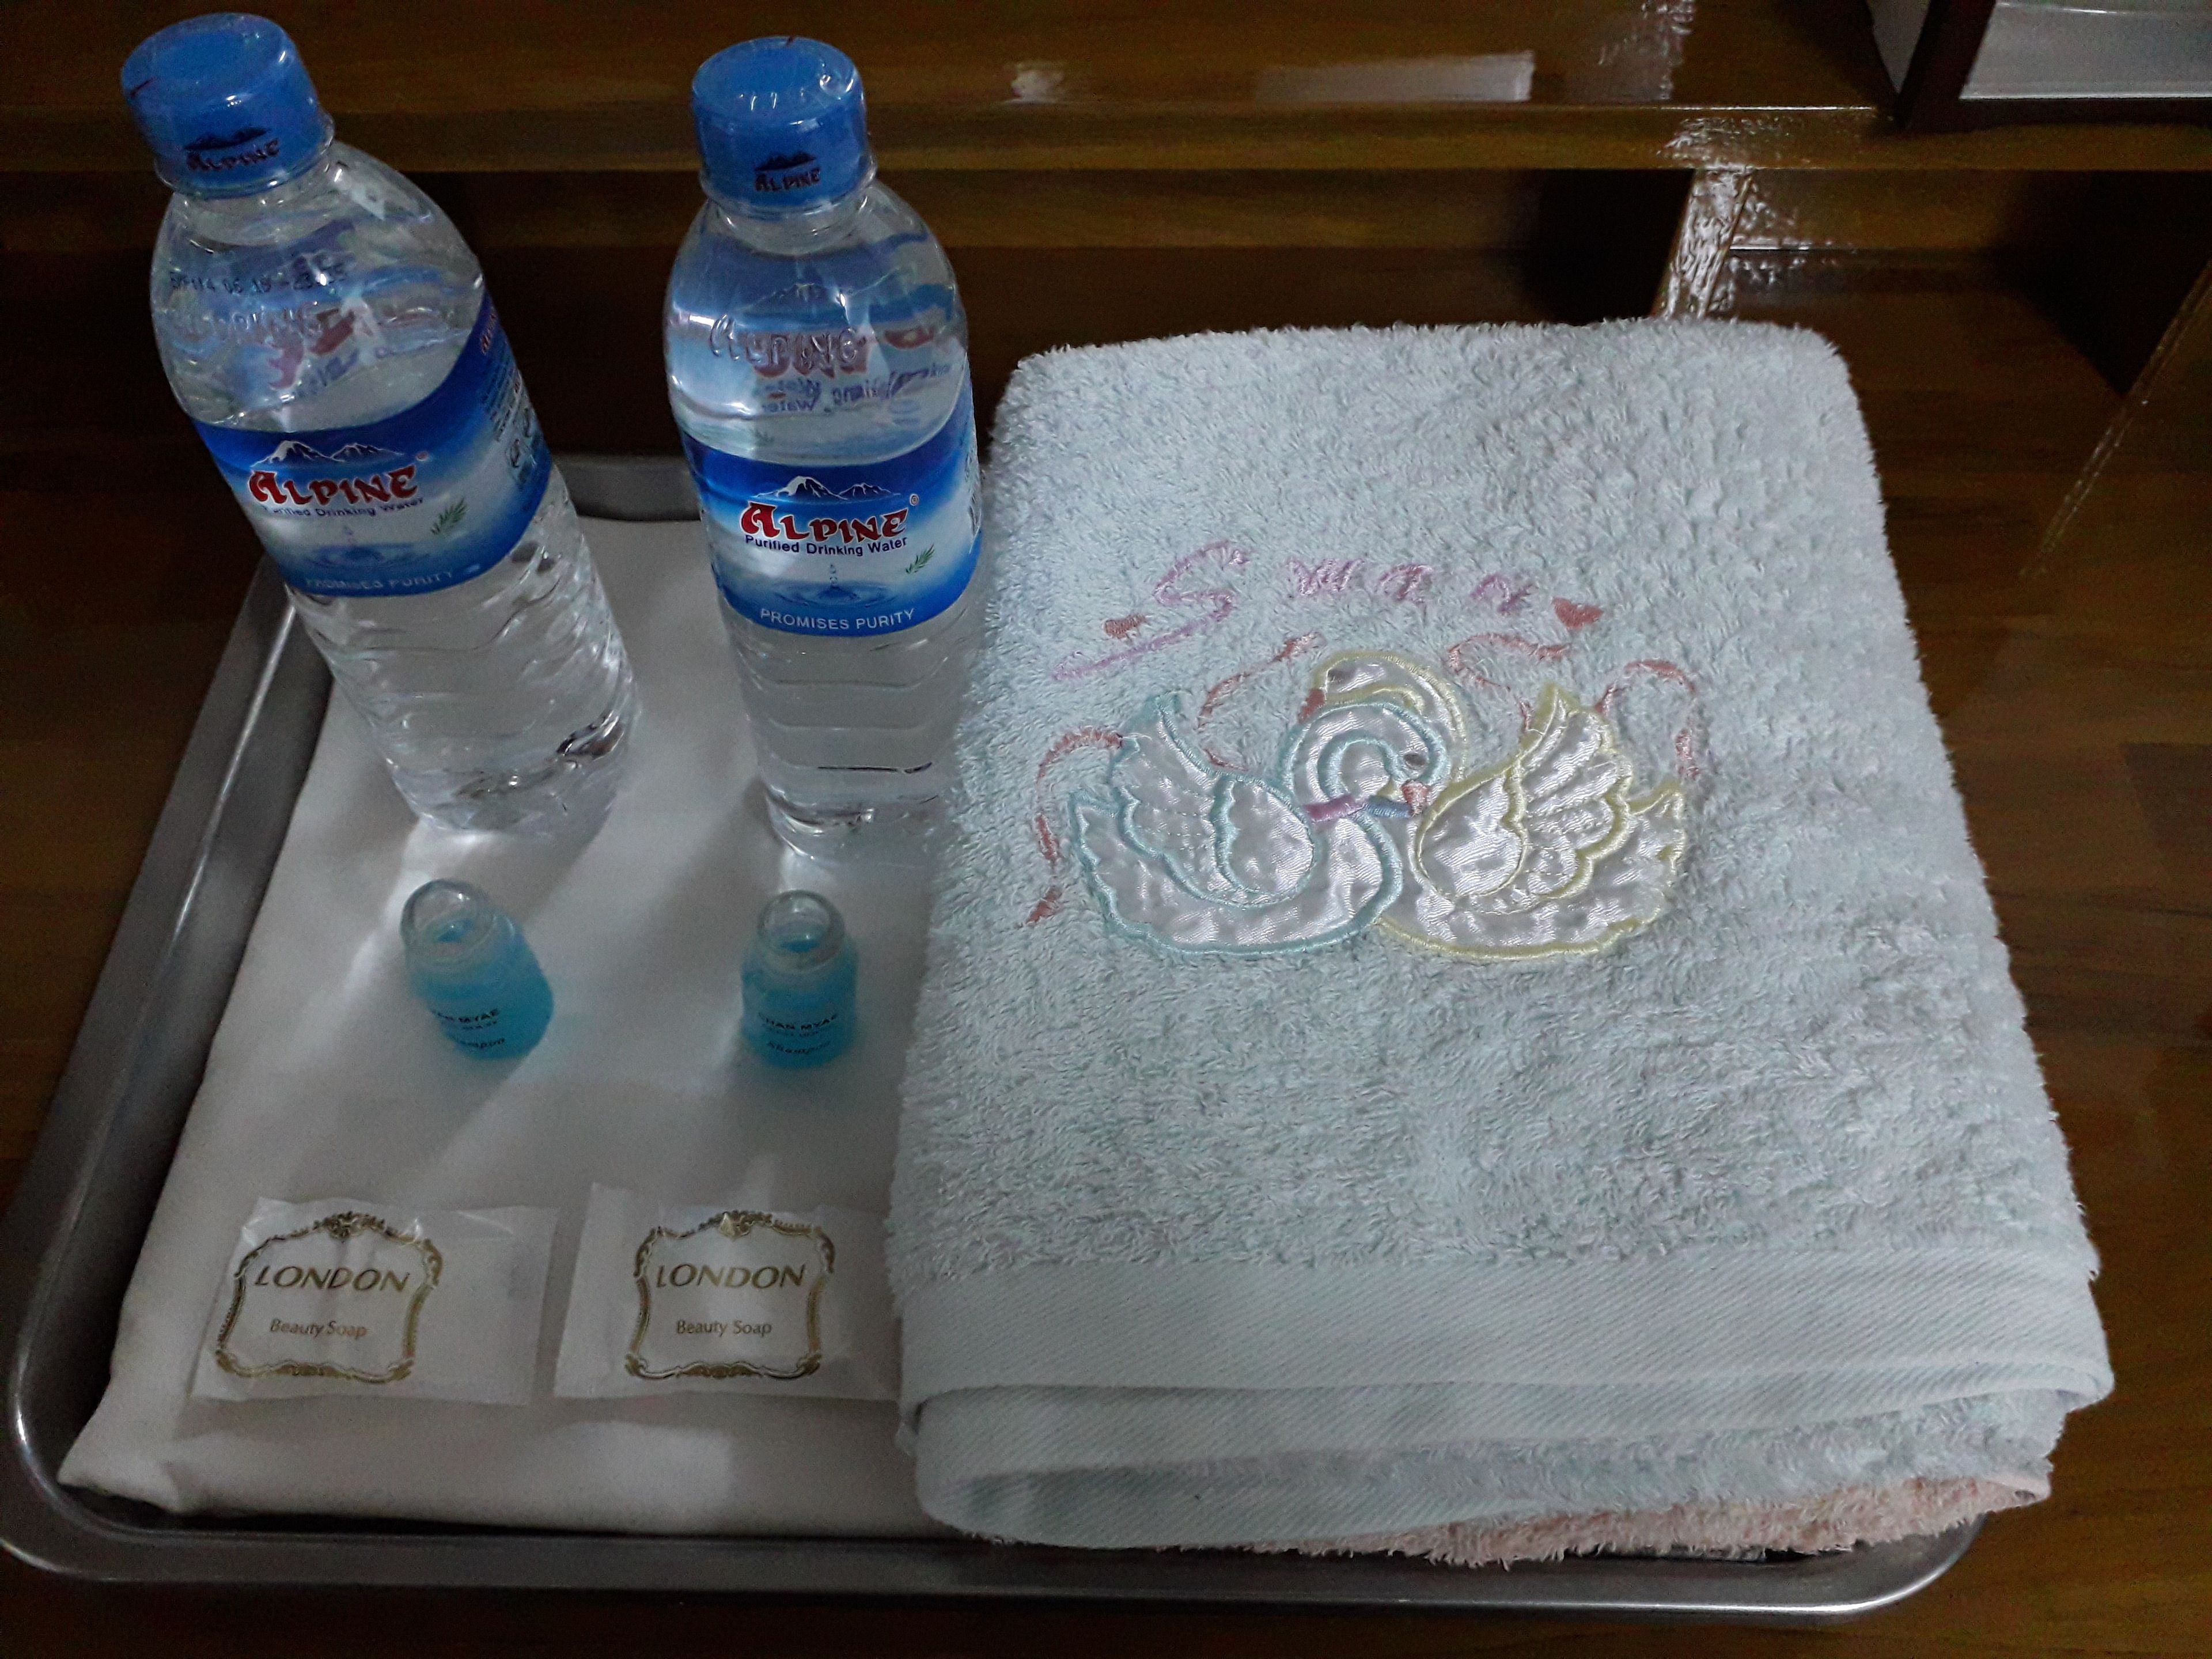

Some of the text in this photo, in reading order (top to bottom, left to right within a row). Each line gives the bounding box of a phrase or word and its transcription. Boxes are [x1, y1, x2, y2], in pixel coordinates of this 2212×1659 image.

[754, 166, 821, 192] ALPINE
[248, 464, 418, 505] ALPINE
[315, 507, 376, 517] Drinking
[382, 496, 424, 512] Water
[740, 500, 909, 544] ALPINE
[745, 534, 908, 557] Purified Drinking Water
[760, 608, 915, 630] PROMISES PURITY
[255, 1266, 410, 1292] LONDON
[655, 1263, 806, 1289] LONDON
[270, 1318, 369, 1339] Beauty Soap
[676, 1320, 772, 1338] Beauty Soap
